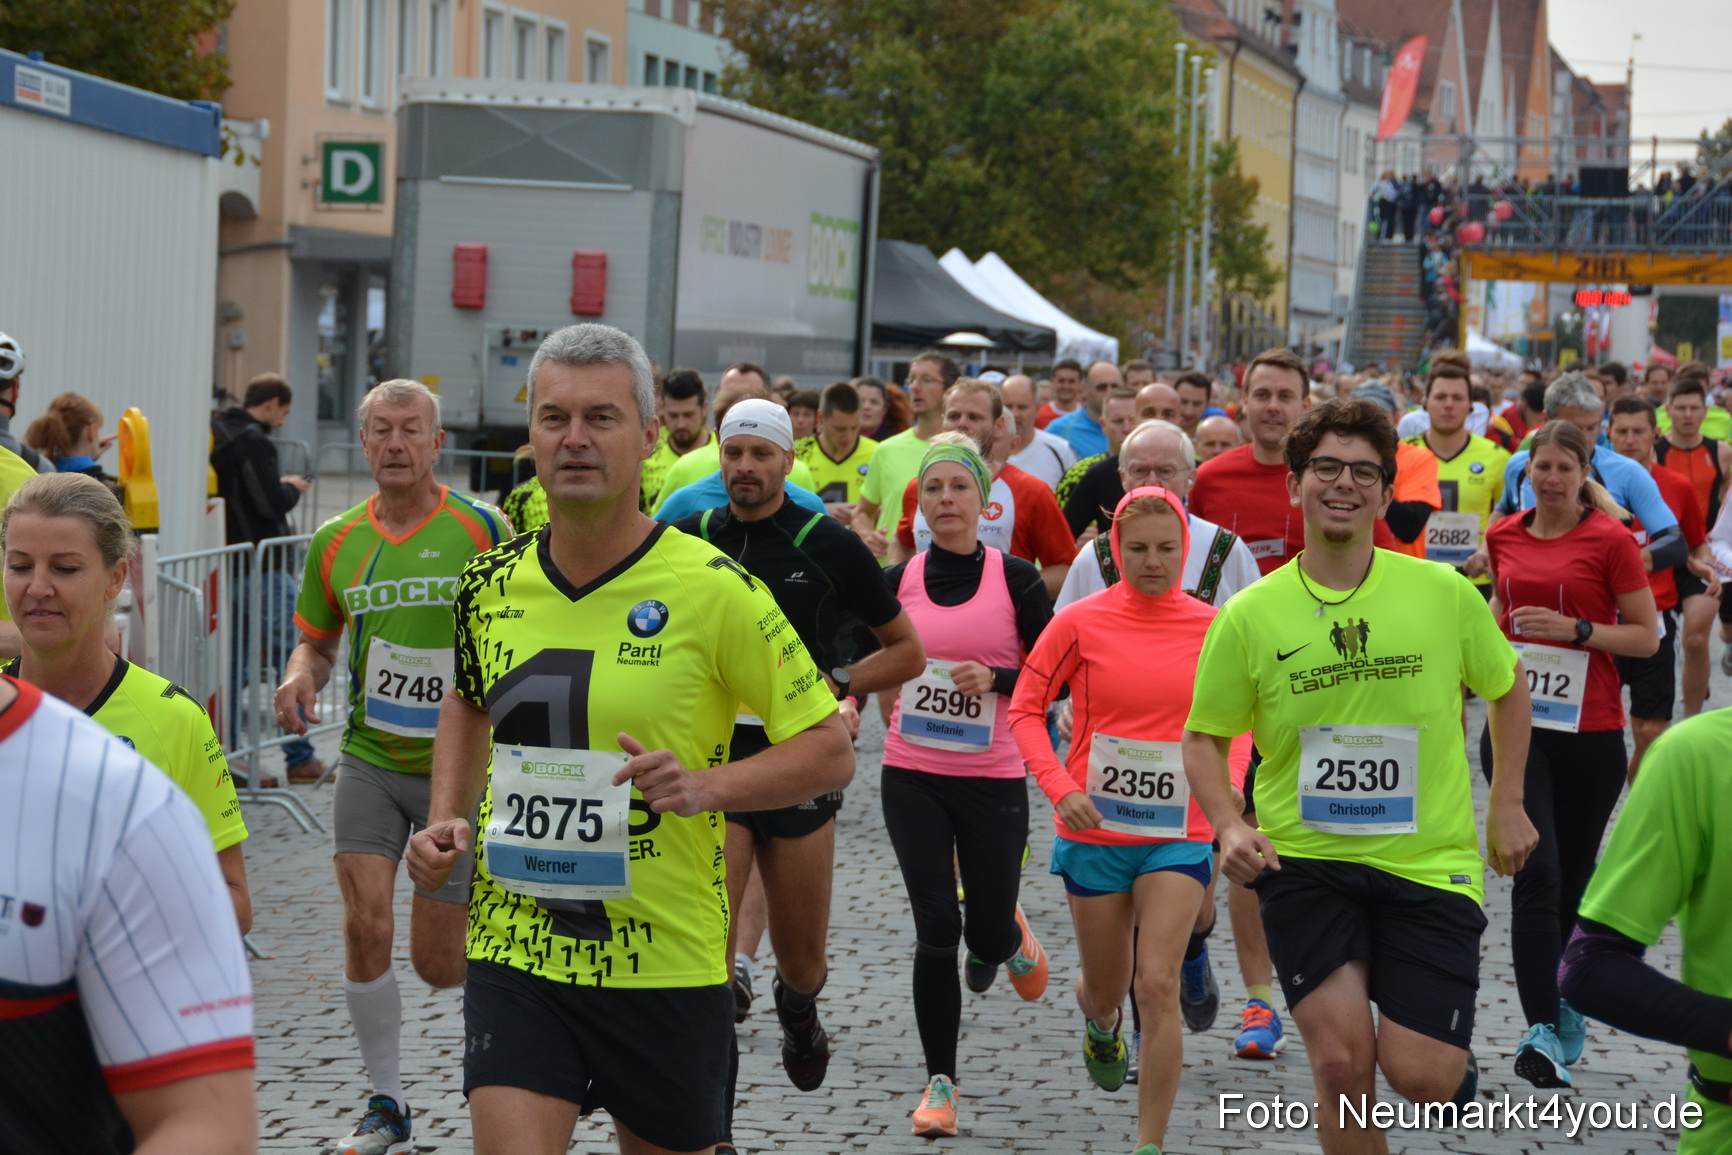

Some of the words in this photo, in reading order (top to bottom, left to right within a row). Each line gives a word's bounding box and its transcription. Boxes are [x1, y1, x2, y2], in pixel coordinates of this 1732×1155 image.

[331, 150, 375, 196] D
[1574, 257, 1632, 280] ZIEL
[1429, 528, 1470, 545] 2682
[343, 577, 458, 616] BOCK
[634, 600, 667, 614] BMW
[399, 654, 432, 665] BOCK
[617, 657, 660, 667] Neumarkt
[791, 677, 806, 689] THE
[1289, 670, 1308, 681] SC
[377, 669, 443, 703] 2748
[784, 690, 798, 702] 100
[914, 685, 982, 719] 2596
[926, 722, 964, 737] Stefanie
[1343, 735, 1384, 745] BOCK
[1128, 748, 1163, 759] BOCK
[534, 762, 585, 777] BOCK
[1315, 758, 1399, 792] 2530
[1101, 766, 1175, 800] 2356
[221, 808, 234, 819] 100
[504, 793, 603, 842] 2675
[1116, 804, 1155, 820] Viktoria
[1329, 803, 1386, 818] Christoph
[524, 855, 577, 874] Werner
